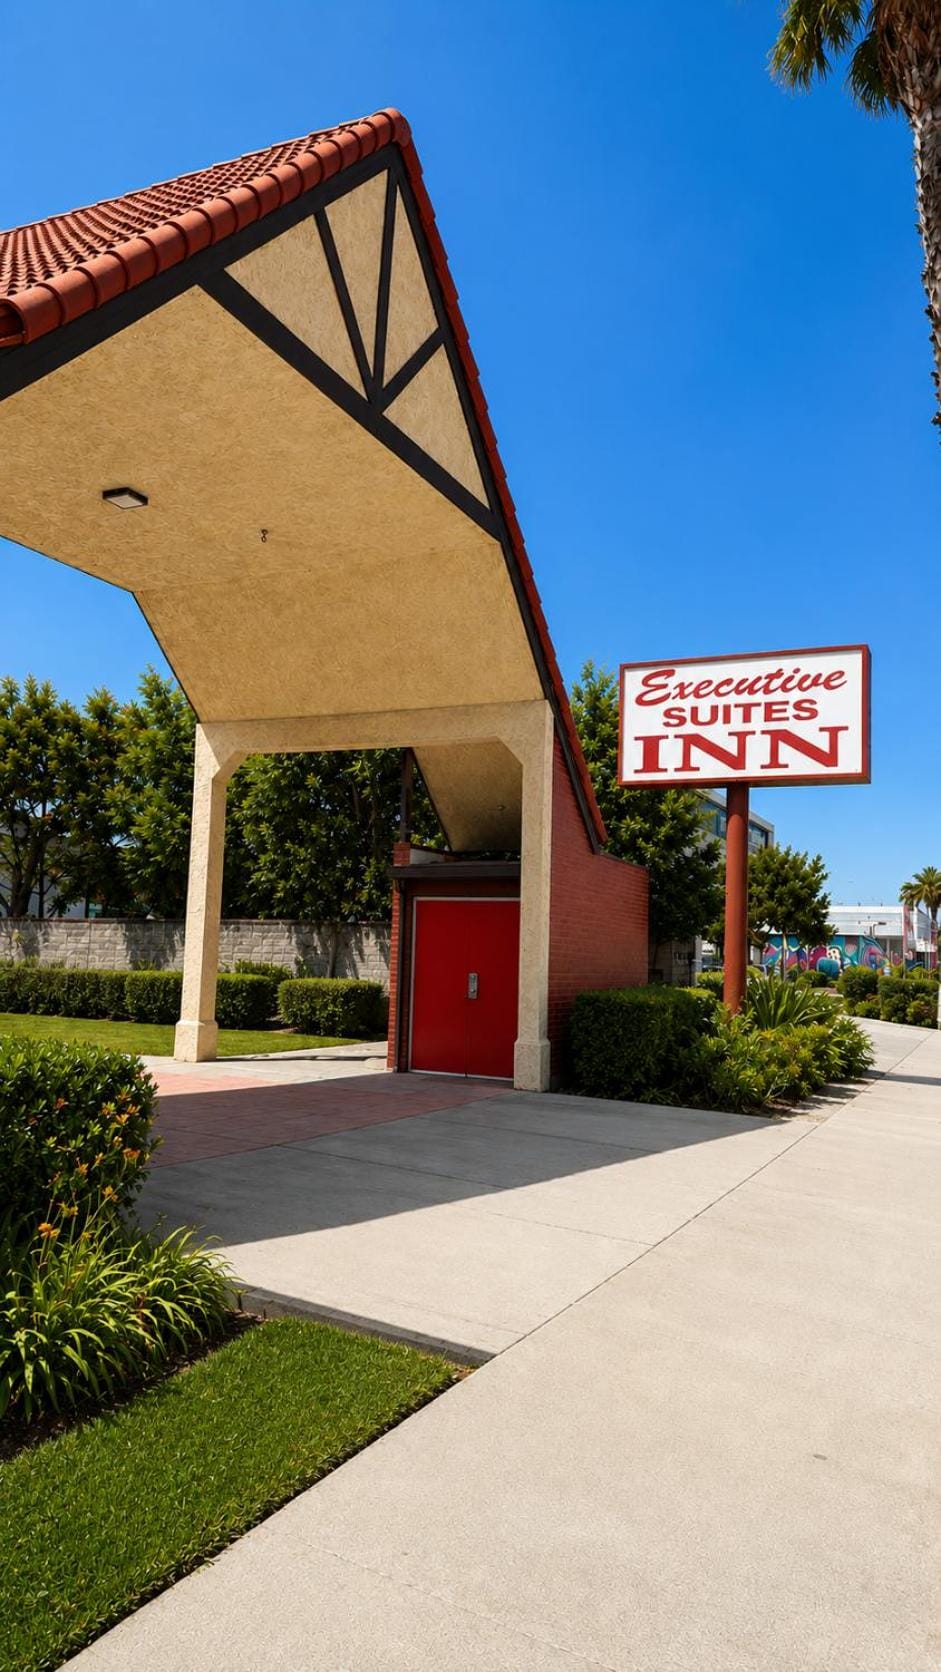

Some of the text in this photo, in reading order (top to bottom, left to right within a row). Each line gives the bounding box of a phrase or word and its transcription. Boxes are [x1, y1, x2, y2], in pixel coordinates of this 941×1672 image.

[635, 667, 847, 707] Executive
[662, 699, 819, 727] SUITES
[633, 726, 849, 774] INN
